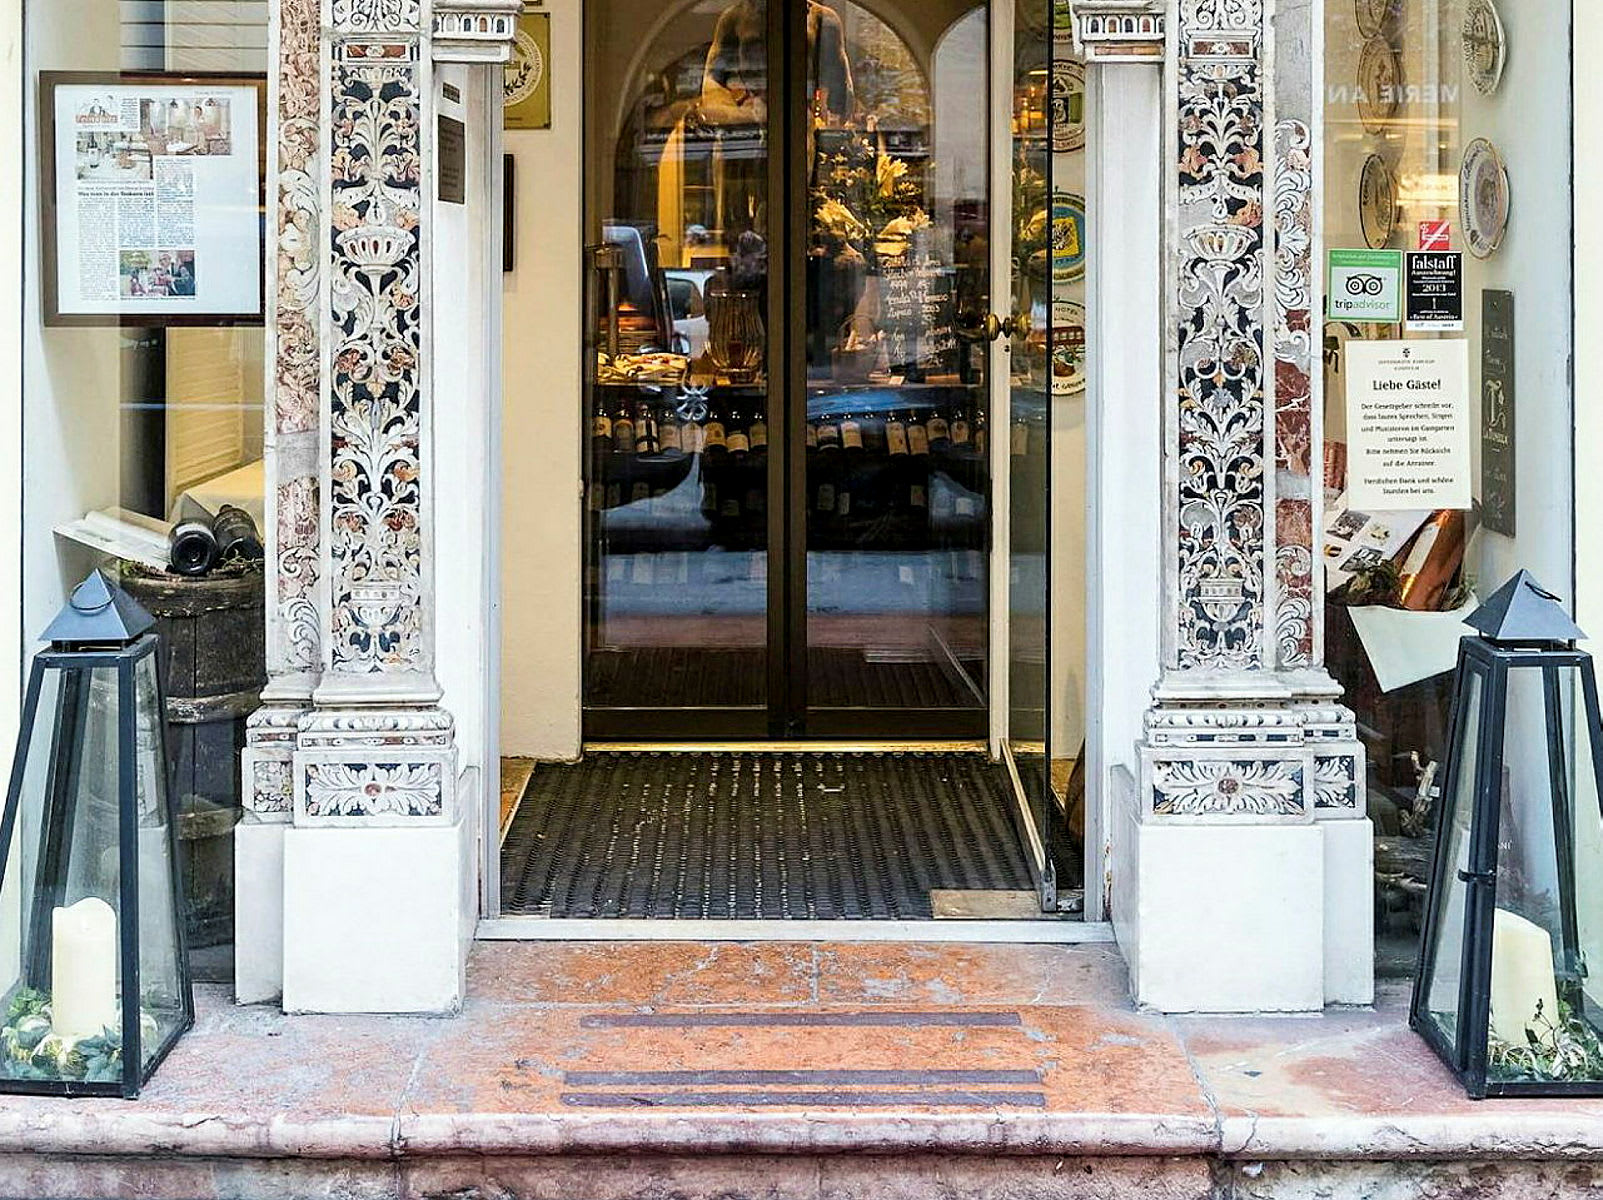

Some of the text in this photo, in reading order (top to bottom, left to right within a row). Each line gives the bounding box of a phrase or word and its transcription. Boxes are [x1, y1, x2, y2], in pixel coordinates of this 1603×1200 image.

[1412, 254, 1457, 270] falstaff
[1335, 298, 1390, 311] tripadvisor
[1372, 379, 1441, 391] Liebe Gäste!
